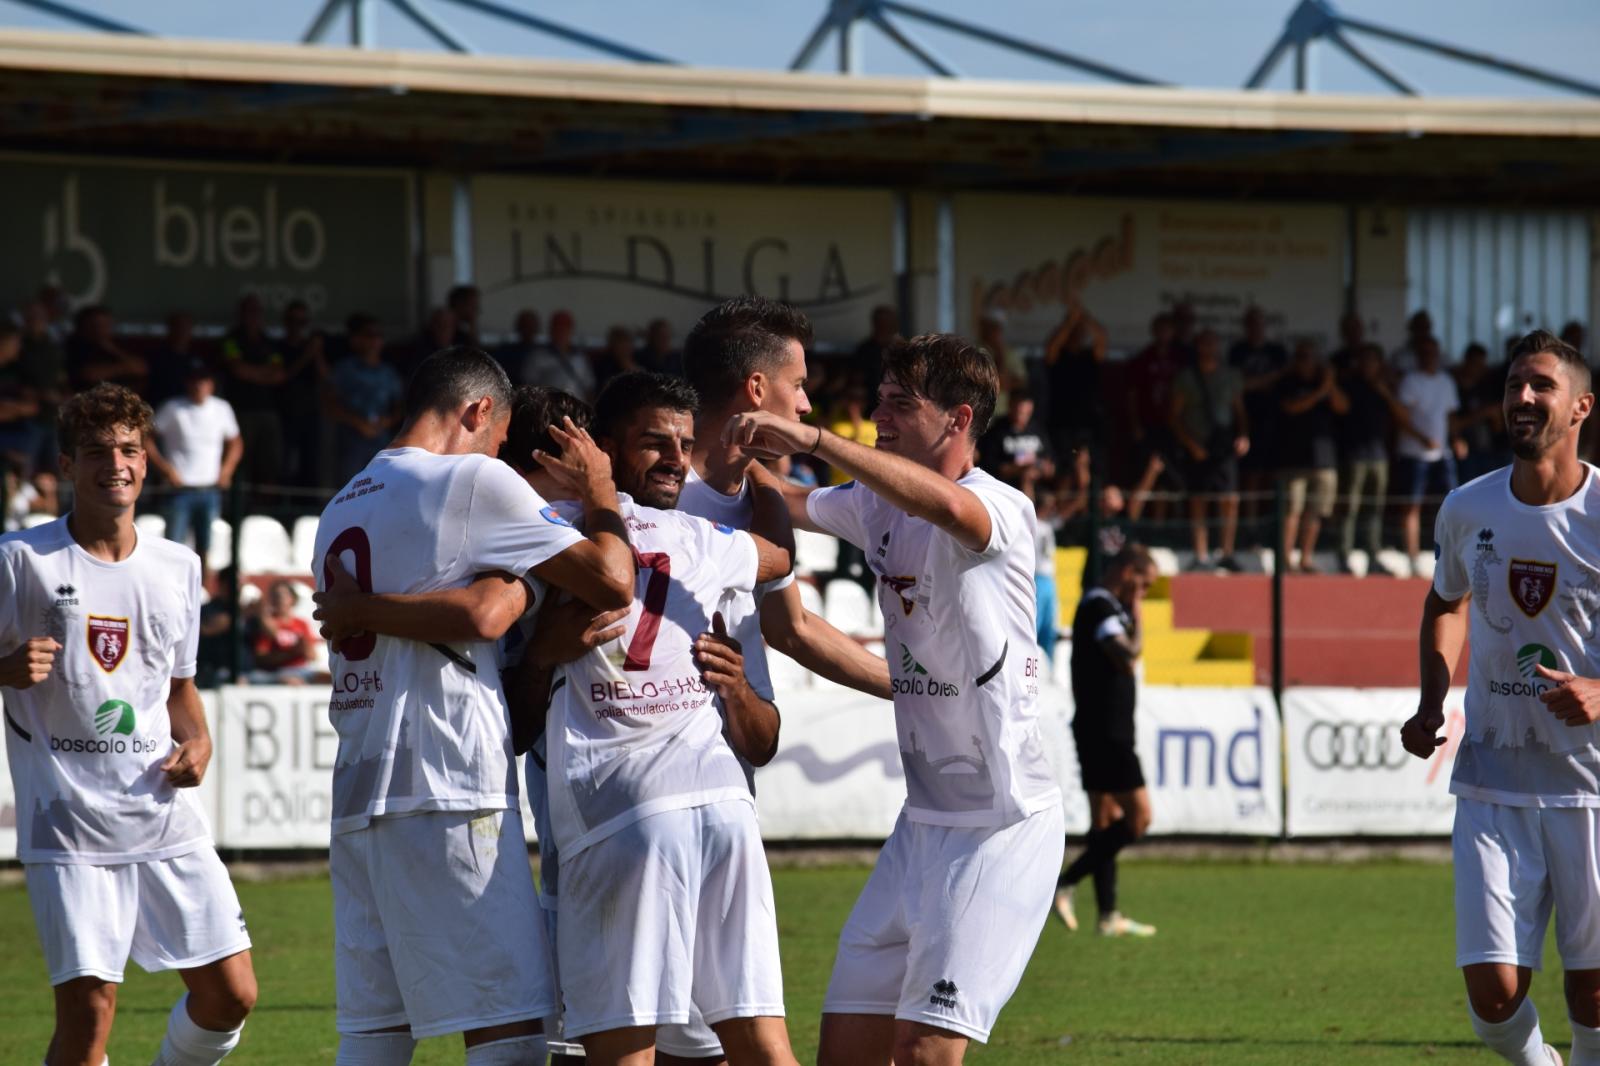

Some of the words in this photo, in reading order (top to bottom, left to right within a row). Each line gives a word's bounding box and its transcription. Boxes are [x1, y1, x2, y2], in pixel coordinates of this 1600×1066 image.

[153, 177, 327, 270] bielo
[623, 544, 671, 671] 7
[51, 734, 126, 754] boscolo
[1156, 706, 1263, 789] md
